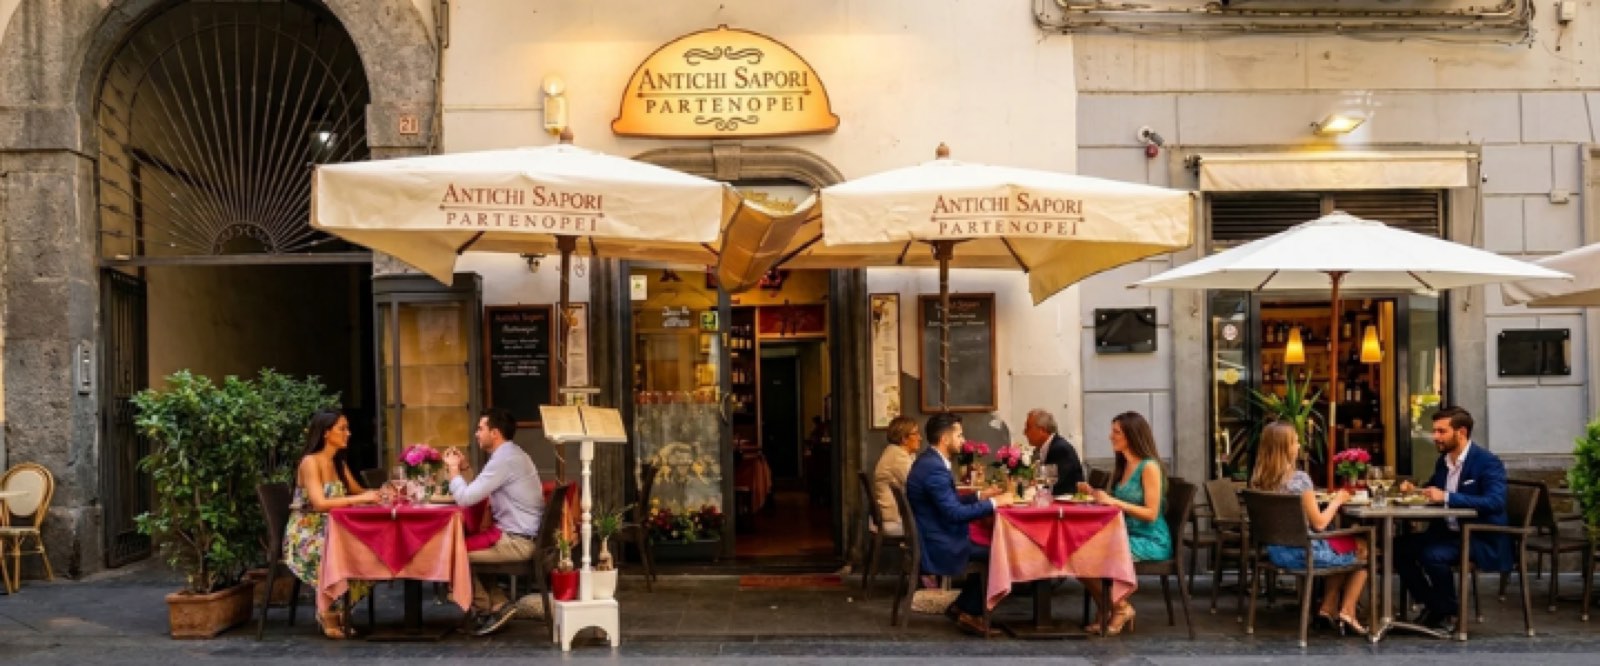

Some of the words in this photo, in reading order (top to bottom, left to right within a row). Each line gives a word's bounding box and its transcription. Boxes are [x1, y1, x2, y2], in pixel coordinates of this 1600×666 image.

[638, 68, 726, 90] ANTICHI
[734, 66, 809, 89] SAPORI
[646, 97, 805, 114] PARTENOPEI
[442, 183, 525, 205] ANTICHI
[533, 186, 603, 210] SAPORI
[933, 195, 1010, 214] ANTICHI
[1017, 193, 1083, 214] SAPORI
[446, 212, 597, 232] PARTENOPEI
[939, 221, 1078, 236] PARTENOPEI
